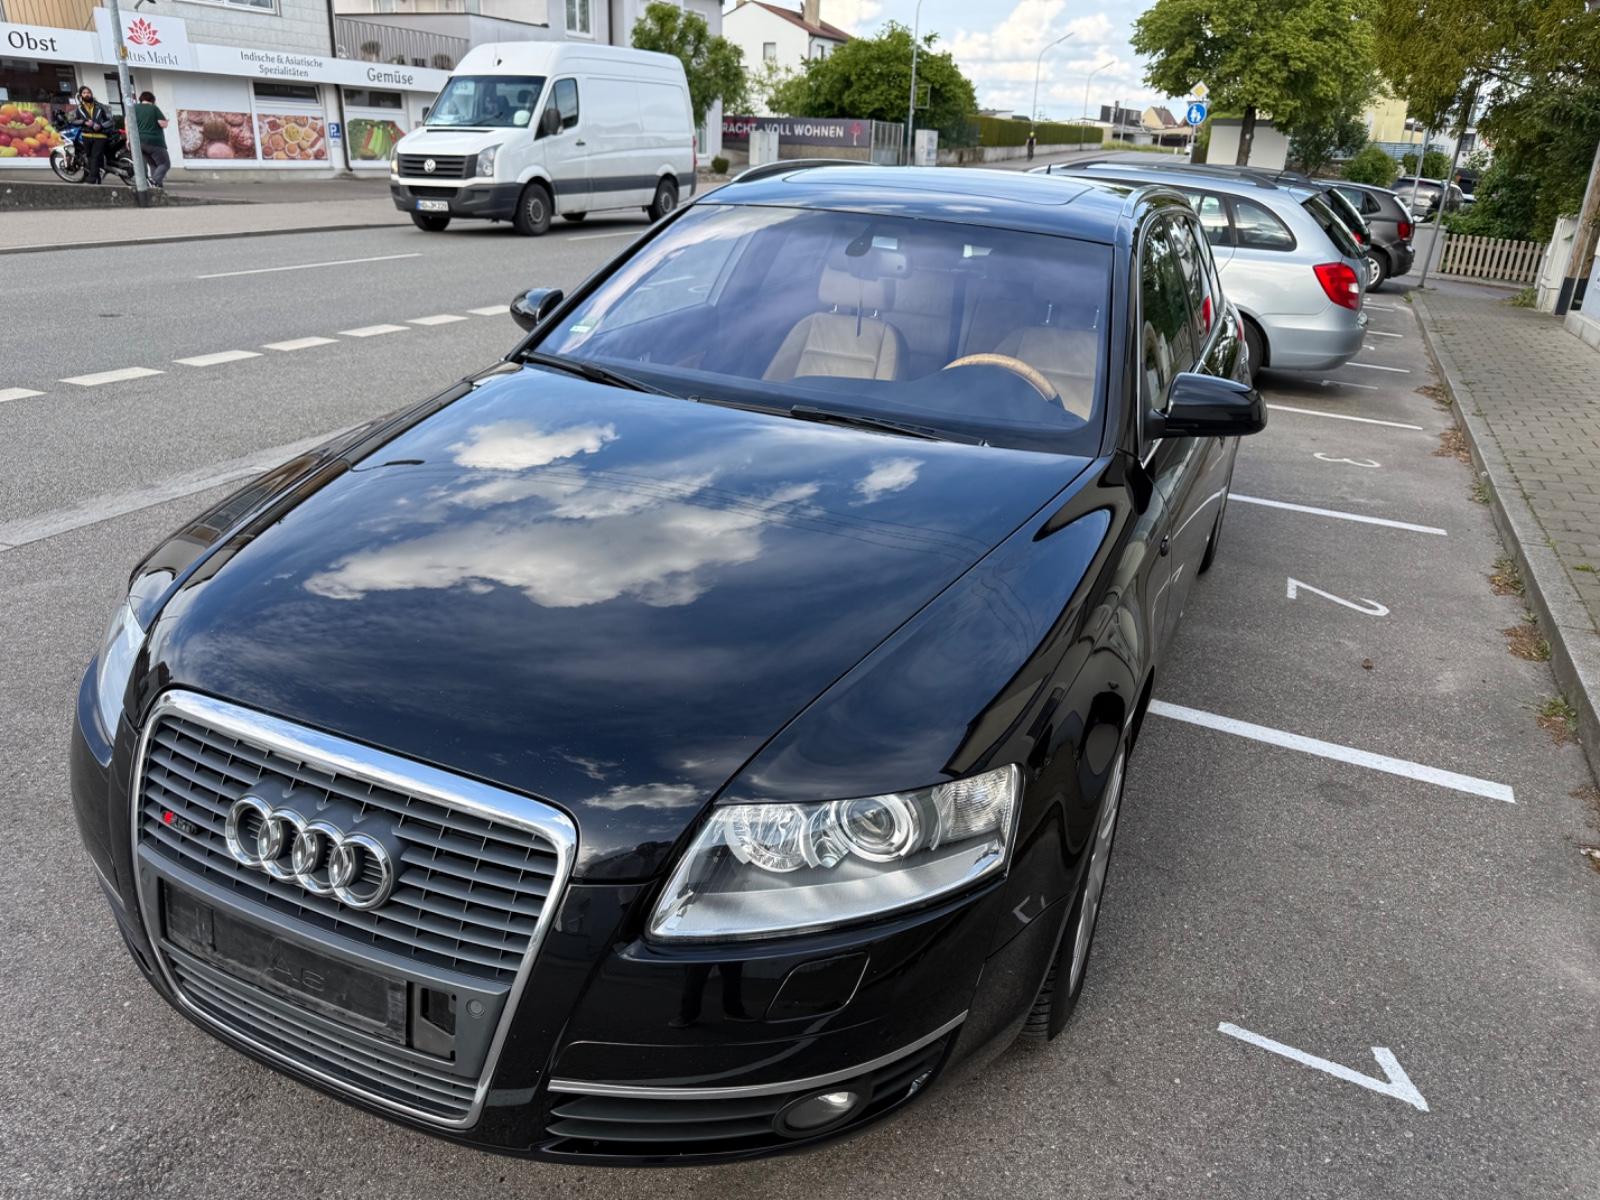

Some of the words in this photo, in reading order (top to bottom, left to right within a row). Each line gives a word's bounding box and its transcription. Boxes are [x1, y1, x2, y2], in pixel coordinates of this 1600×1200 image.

[8, 30, 57, 52] Obst
[147, 51, 179, 65] Markt
[240, 50, 275, 64] Indische
[285, 56, 323, 69] Asiatische
[259, 64, 309, 77] Spezialitäten
[366, 67, 414, 84] Gemüse
[765, 123, 791, 136] VOLL
[793, 124, 844, 137] WOHNEN
[1313, 451, 1381, 468] 3
[1286, 576, 1390, 617] 2
[1217, 1021, 1430, 1112] 1
